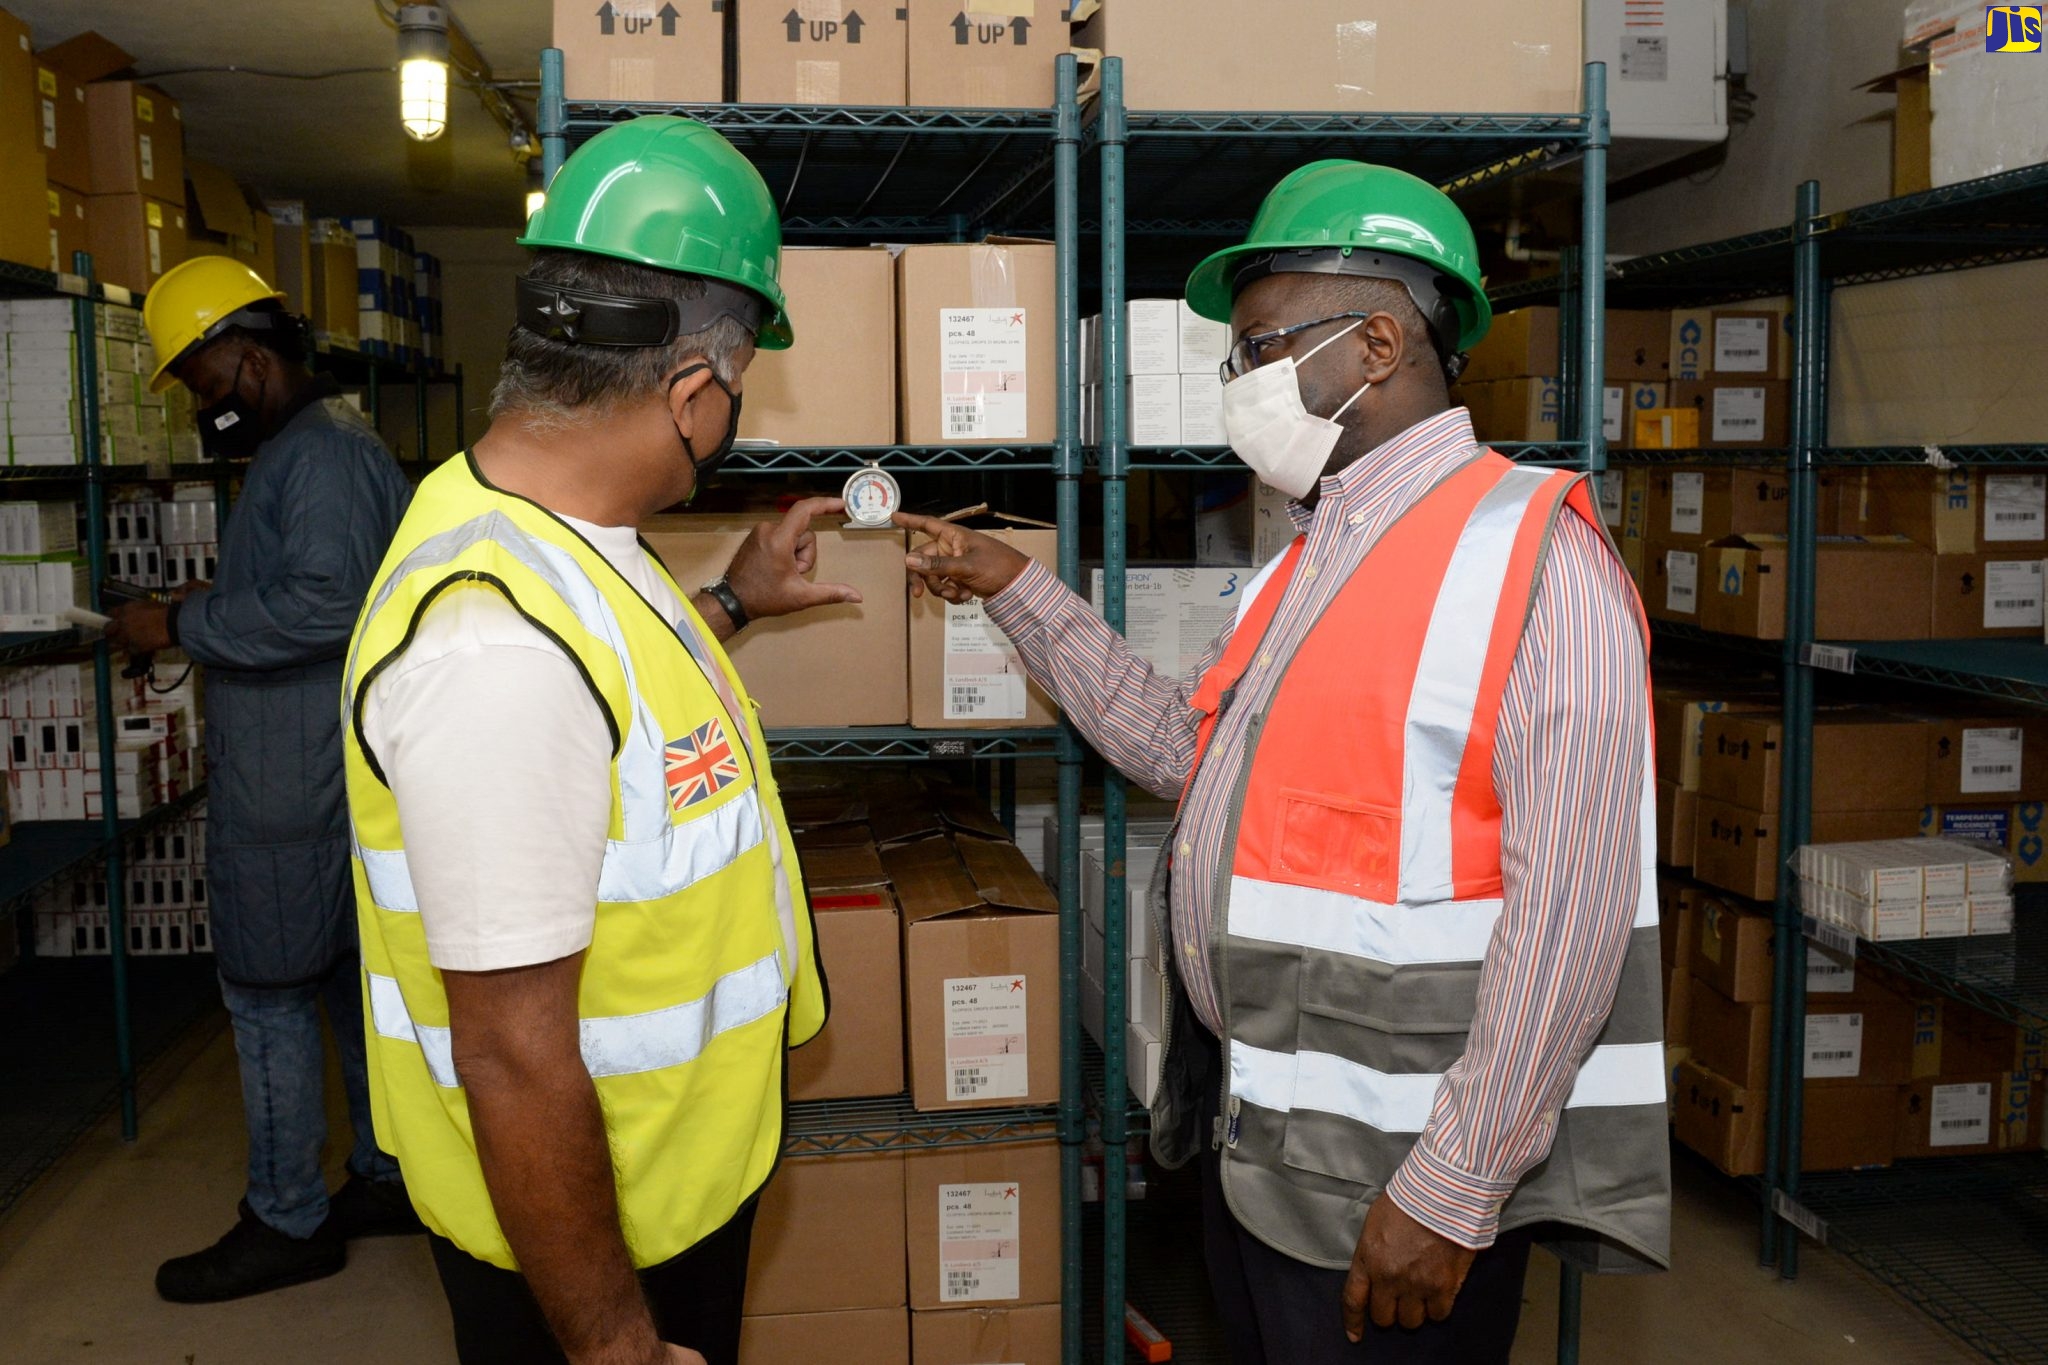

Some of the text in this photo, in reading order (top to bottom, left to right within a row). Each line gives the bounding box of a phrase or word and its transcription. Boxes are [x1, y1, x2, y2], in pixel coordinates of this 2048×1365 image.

[624, 17, 653, 35] UP
[810, 22, 838, 42] UP
[978, 24, 1005, 44] UP
[1772, 487, 1789, 500] UP
